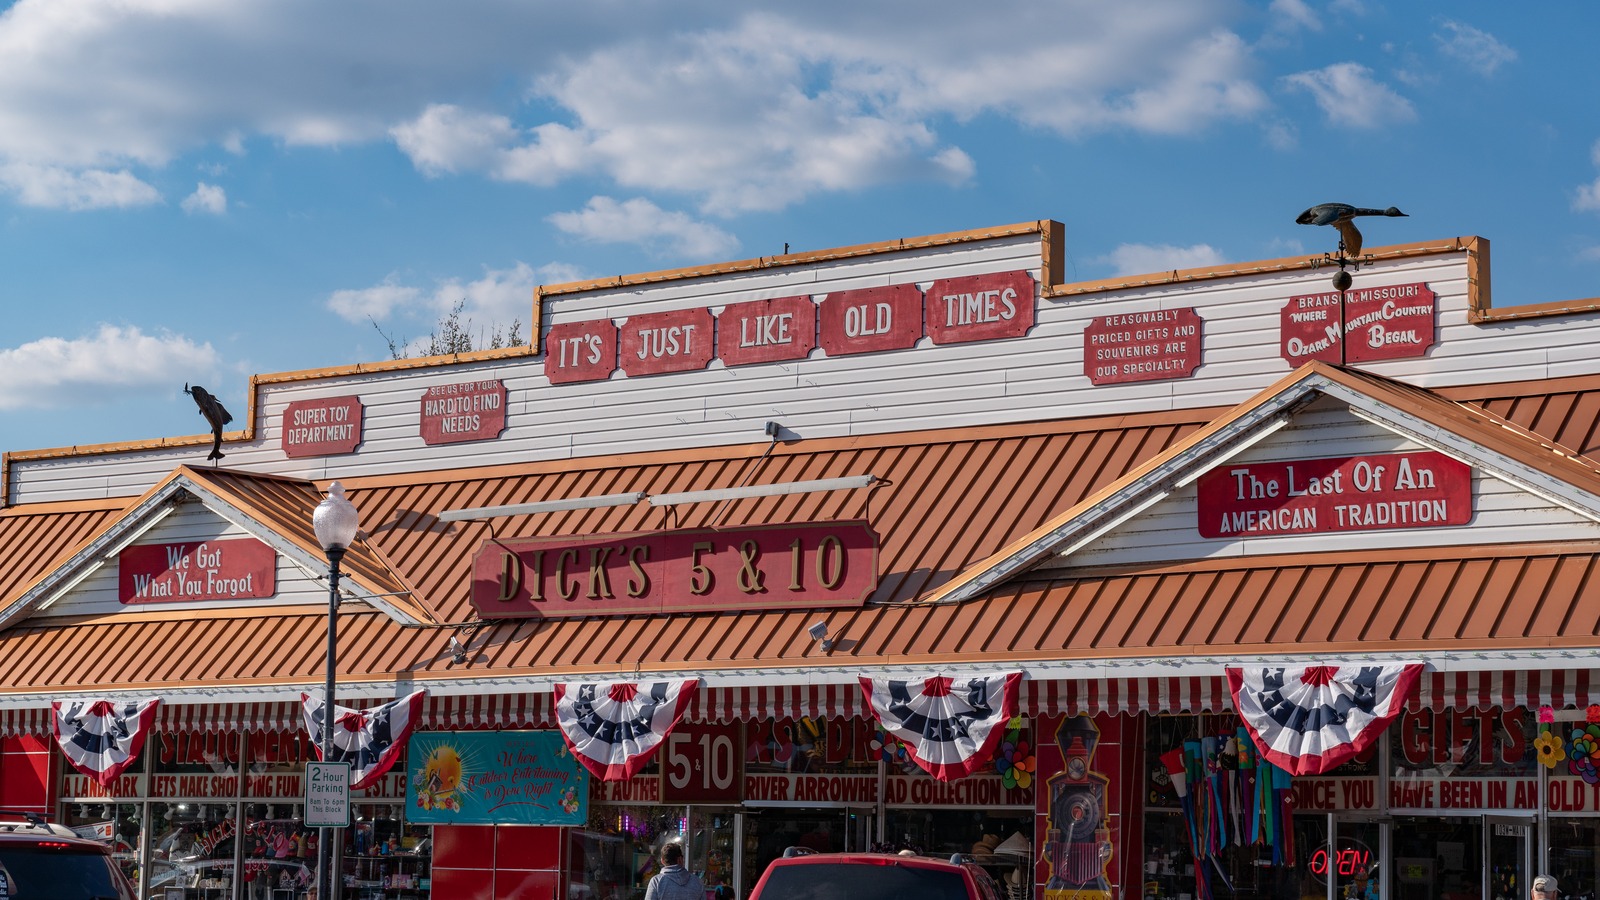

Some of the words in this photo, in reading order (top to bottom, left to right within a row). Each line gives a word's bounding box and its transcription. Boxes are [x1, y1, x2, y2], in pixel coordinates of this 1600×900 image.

[1360, 285, 1419, 301] MISSOURI
[559, 334, 602, 368] IT'S
[636, 325, 695, 360] JUST
[740, 313, 793, 348] LIKE
[845, 303, 892, 339] OLD
[943, 287, 1017, 327] TIMES
[1105, 310, 1179, 327] REASONABLY
[1091, 332, 1131, 345] PRICED
[1135, 328, 1168, 340] GIFTS
[1174, 325, 1195, 337] AND
[1097, 345, 1159, 360] SOUVENIRS
[1164, 342, 1186, 354] ARE
[1097, 366, 1118, 377] OUR
[1123, 359, 1186, 374] SPECIALTY
[431, 386, 446, 396] SEE
[447, 384, 458, 394] US
[459, 382, 475, 393] FOR
[476, 380, 498, 392] YOUR
[294, 408, 326, 426] SUPER
[329, 406, 350, 422] TOY
[425, 397, 454, 417] HARD
[456, 396, 471, 413] TO
[473, 393, 500, 411] FIND
[288, 424, 354, 444] DEPARTMENT
[441, 415, 480, 434] NEEDS
[1231, 468, 1279, 500] The
[1287, 465, 1344, 498] Last
[1353, 461, 1385, 492] Of
[1394, 457, 1435, 490] An
[1220, 507, 1317, 534] AMERICAN
[1334, 499, 1447, 527] TRADITION
[166, 545, 190, 571] We
[196, 543, 222, 569] Got
[497, 544, 650, 602] DICK'S
[689, 541, 716, 595] 5
[737, 538, 764, 593] &
[788, 534, 844, 590] 10
[133, 573, 172, 598] What
[176, 572, 202, 596] You
[206, 569, 253, 597] Forgot
[1401, 706, 1527, 764] GIFTS
[497, 748, 538, 767] Where
[312, 767, 321, 781] 2
[323, 772, 344, 782] Hour
[468, 771, 508, 792] Outdoor
[512, 766, 570, 784] Entertaining
[64, 777, 70, 798] A
[152, 776, 177, 797] LETS
[179, 776, 204, 797] MAKE
[276, 776, 300, 798] FUN
[312, 783, 343, 796] Parking
[484, 787, 492, 799] is
[494, 785, 521, 804] Done
[524, 782, 554, 800] Right
[612, 778, 659, 800] AUTHE
[745, 776, 789, 801] RIVER
[911, 778, 1001, 805] COLLECTION
[1291, 780, 1336, 810] SINCE
[1342, 780, 1374, 809] YOU
[1390, 780, 1433, 808] HAVE
[1441, 781, 1483, 808] BEEN
[1488, 781, 1507, 808] IN
[1514, 781, 1538, 808] AN
[1549, 780, 1585, 811] OLD
